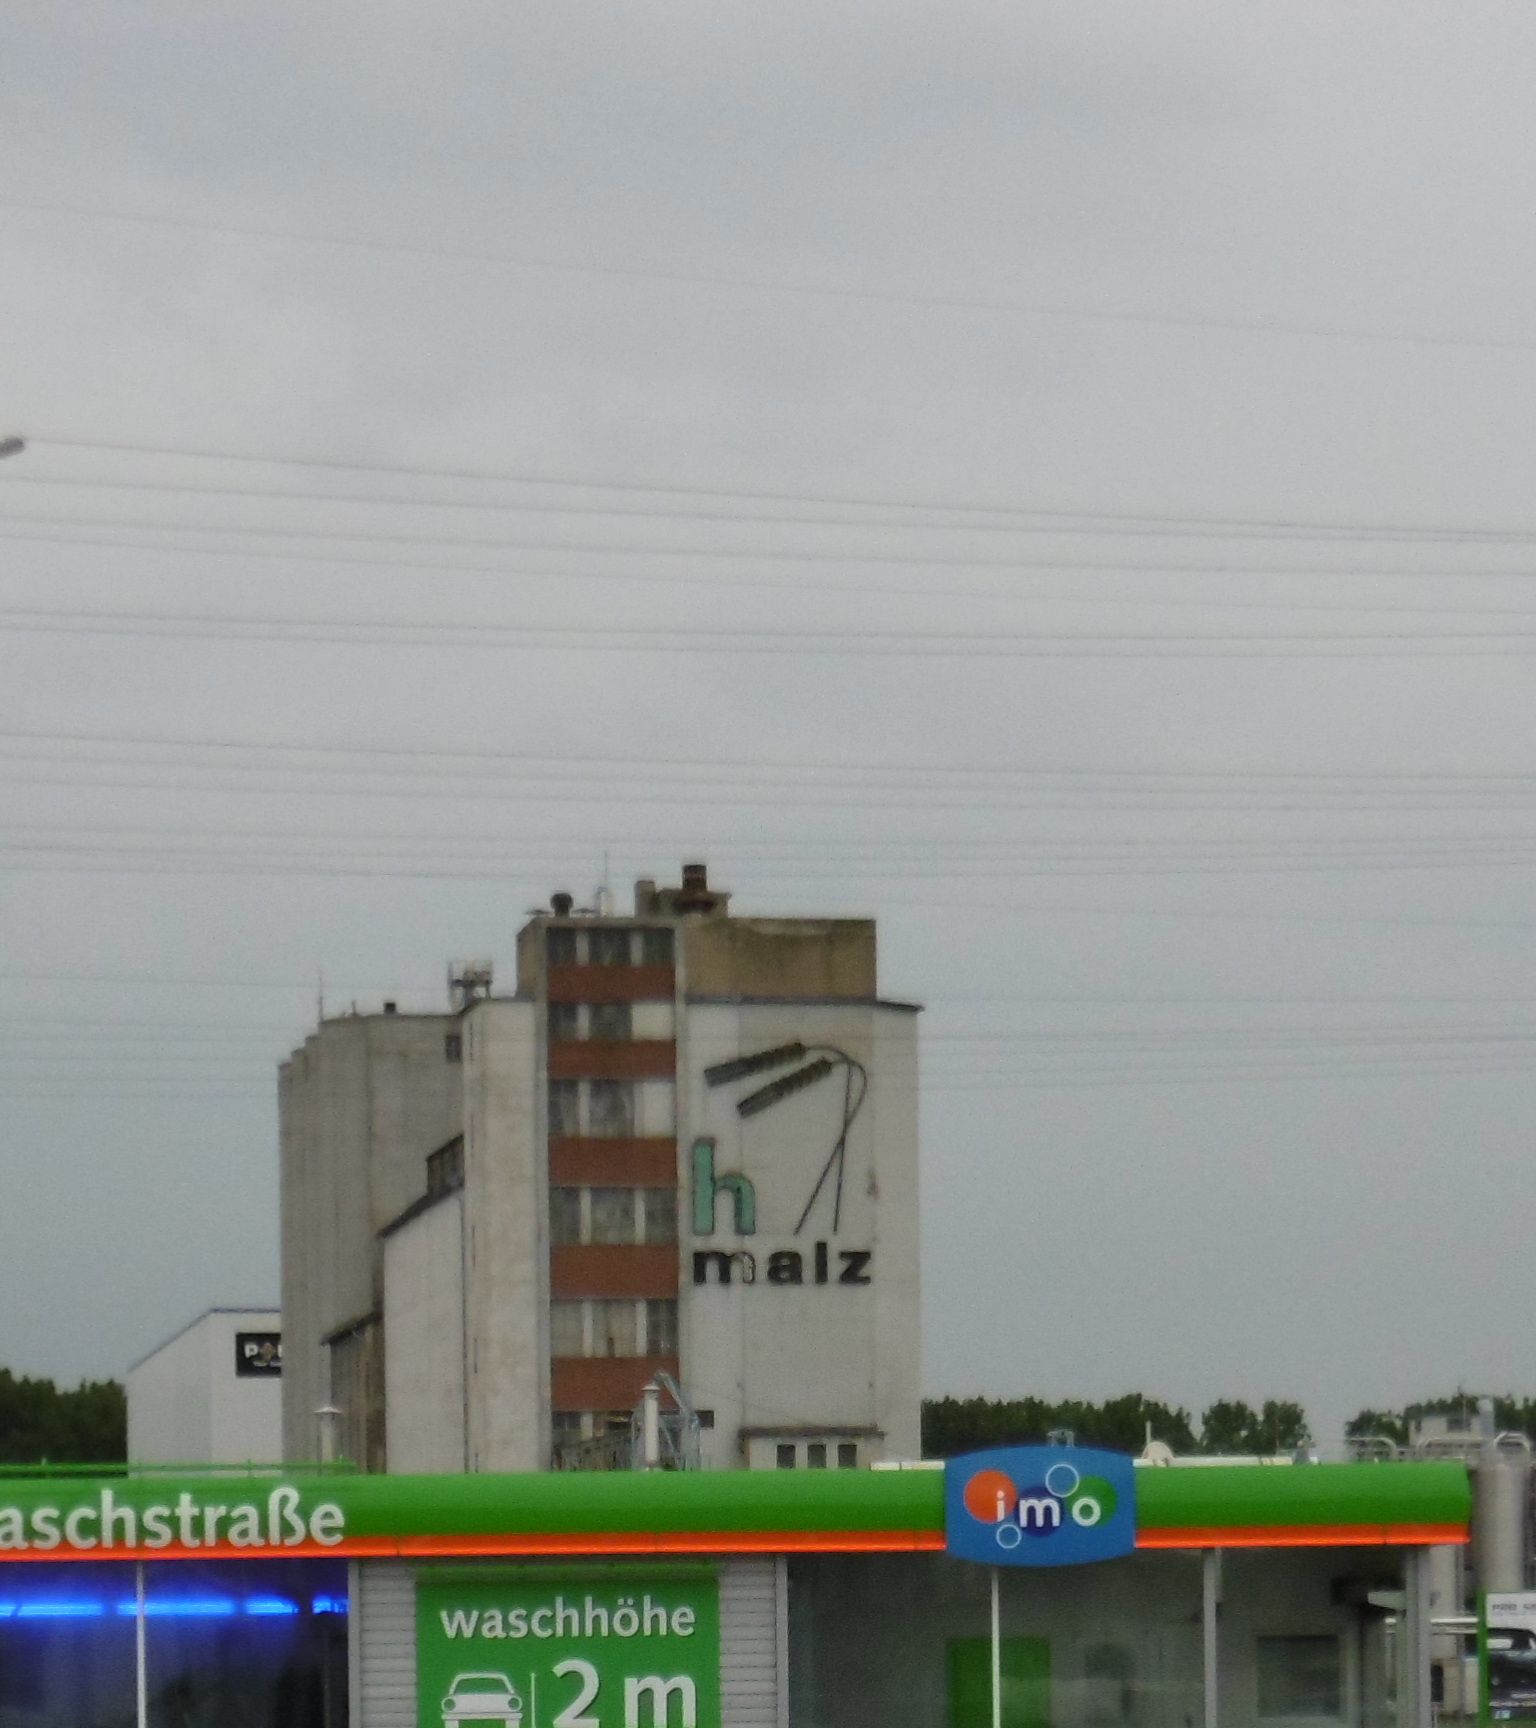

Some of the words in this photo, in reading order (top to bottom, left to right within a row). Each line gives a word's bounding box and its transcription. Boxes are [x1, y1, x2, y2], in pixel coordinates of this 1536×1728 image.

[692, 1137, 756, 1236] h
[692, 1240, 871, 1285] malz
[996, 1490, 1101, 1528] imo
[439, 1595, 697, 1640] waschhöhe
